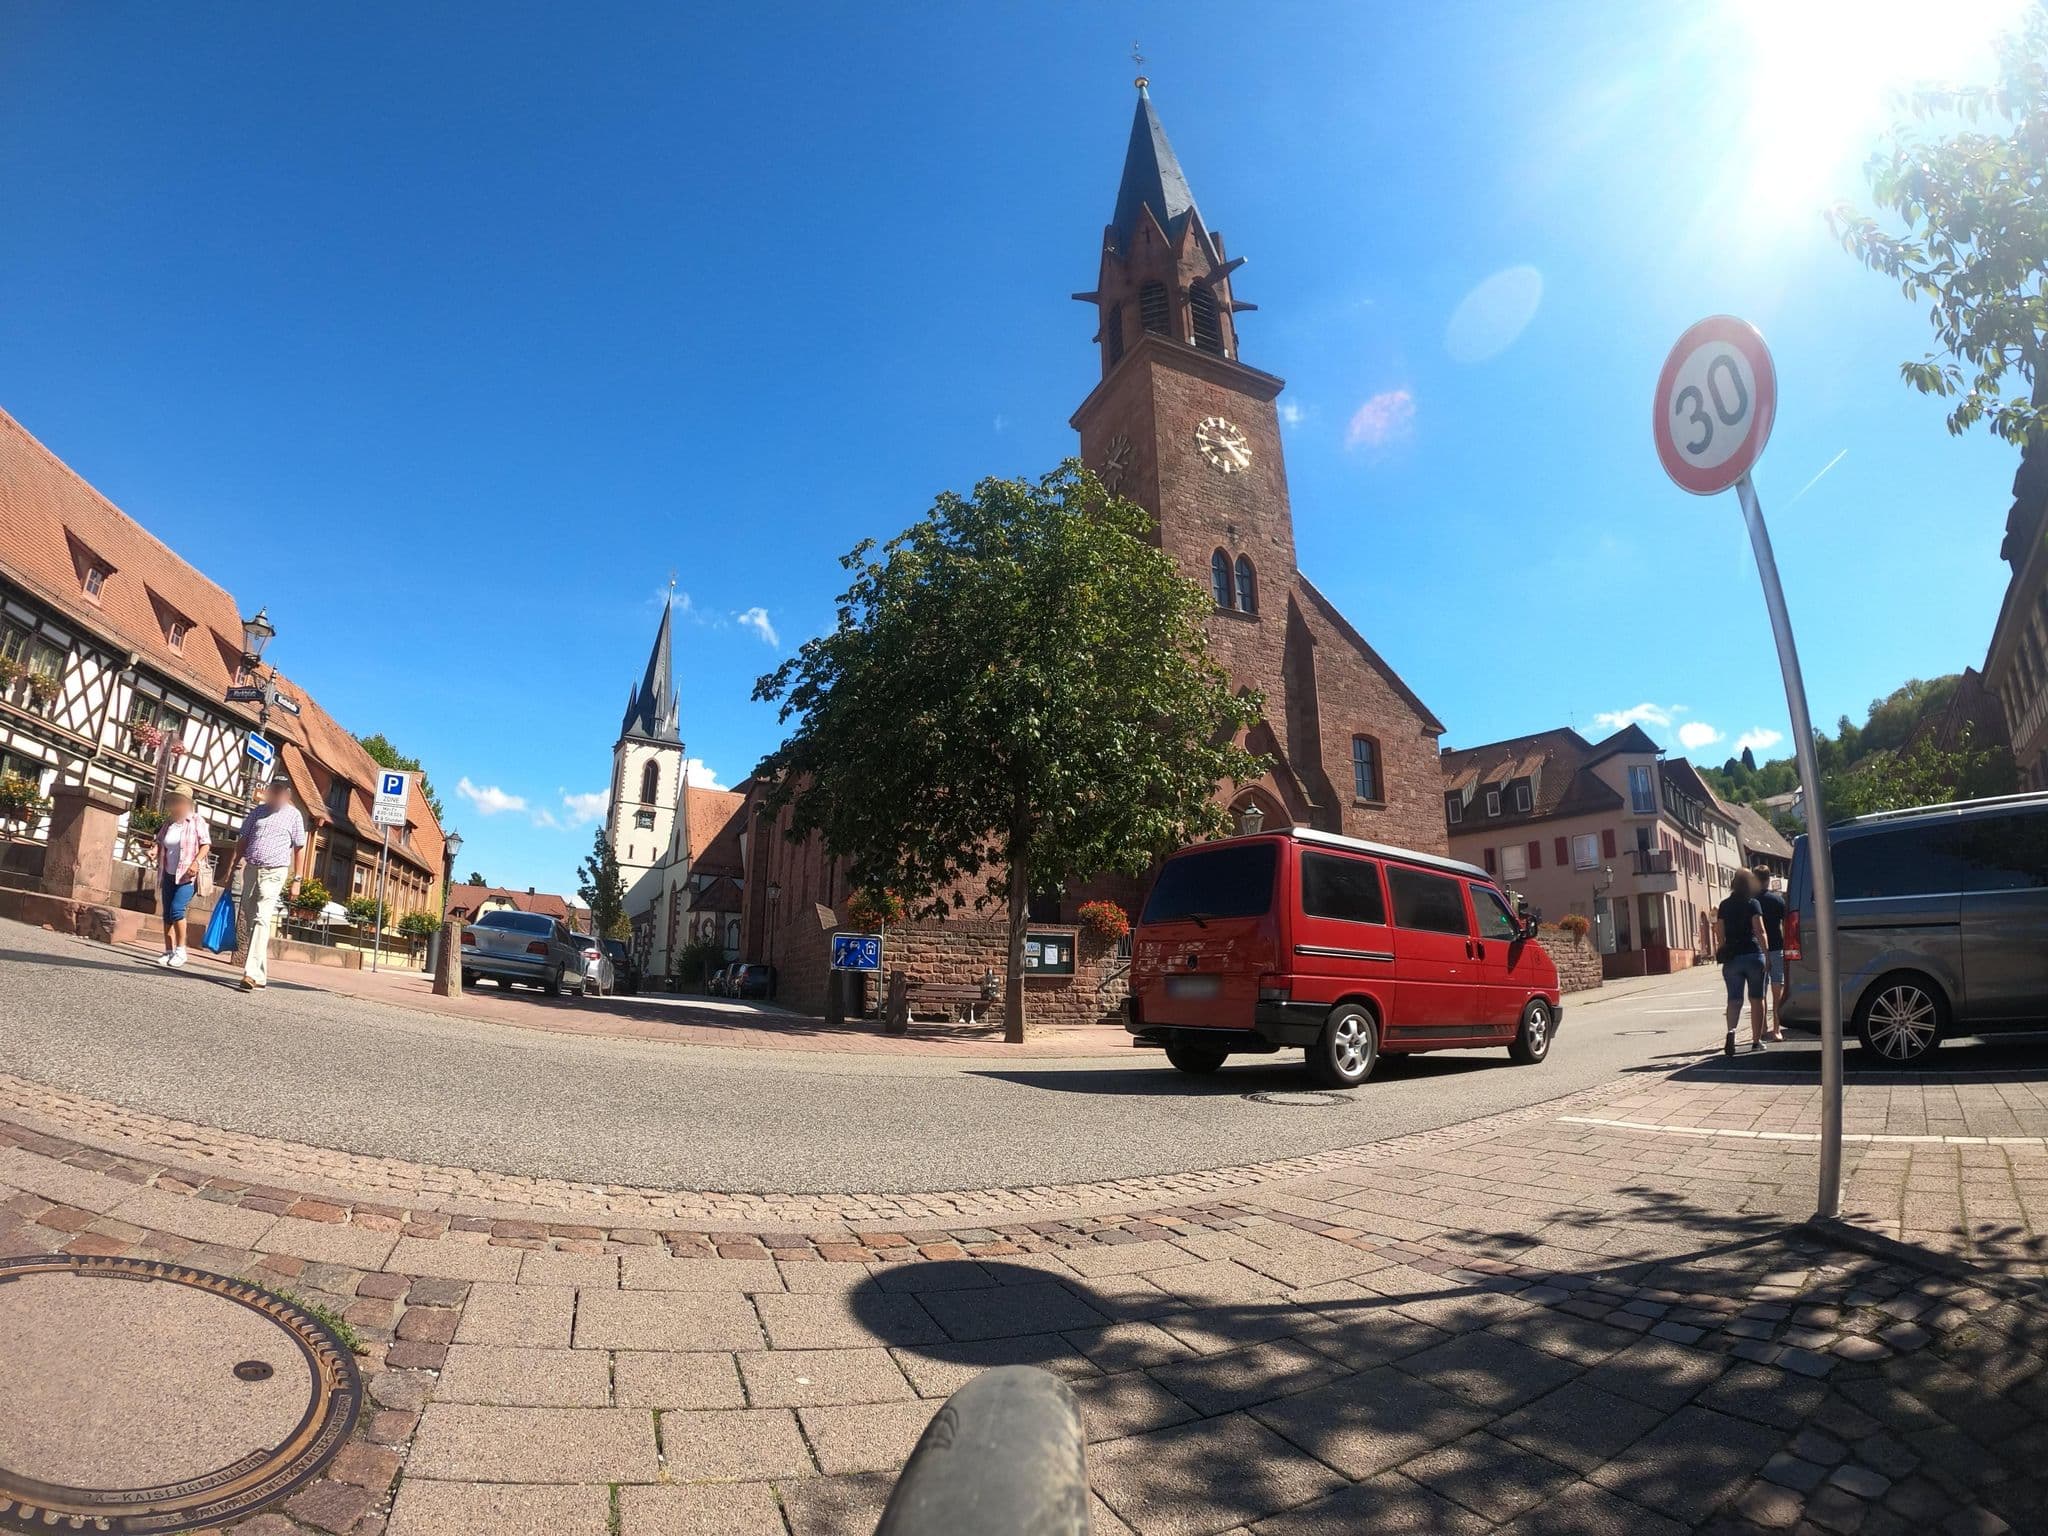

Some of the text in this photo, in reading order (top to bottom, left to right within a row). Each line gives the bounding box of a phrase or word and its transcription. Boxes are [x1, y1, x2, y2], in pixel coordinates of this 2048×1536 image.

[1675, 354, 1748, 455] 30
[387, 776, 400, 792] P
[382, 795, 399, 803] ZONE
